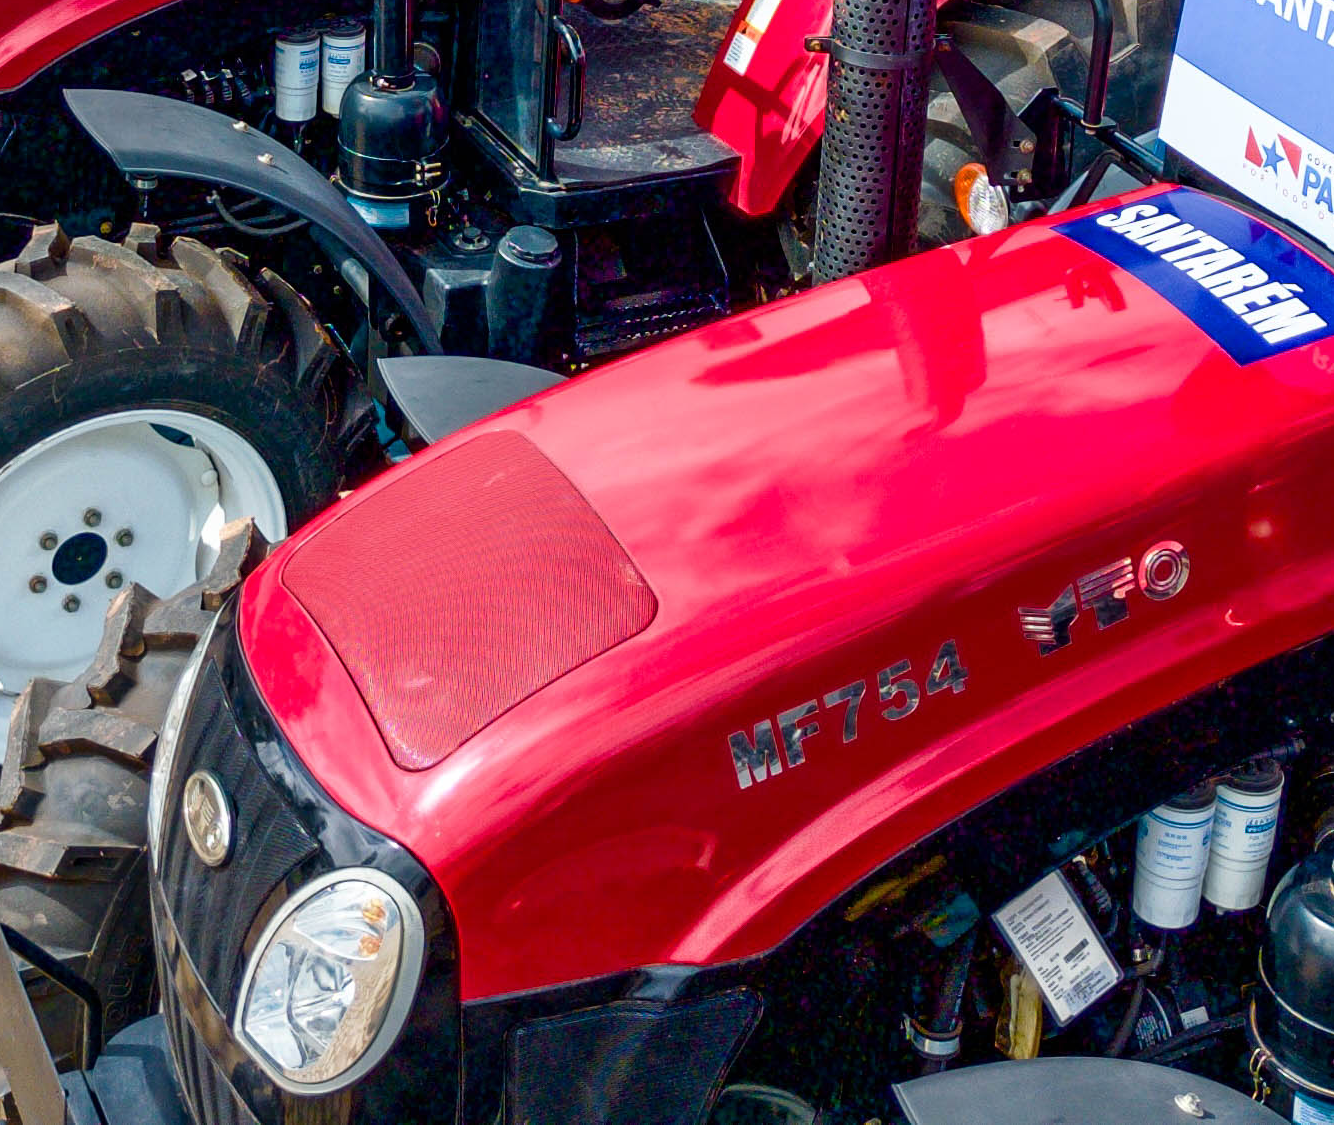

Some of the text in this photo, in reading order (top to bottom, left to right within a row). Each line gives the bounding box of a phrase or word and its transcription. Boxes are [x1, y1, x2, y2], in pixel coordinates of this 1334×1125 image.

[1096, 204, 1328, 344] SANTARÉM
[1018, 540, 1190, 657] YTO
[727, 639, 968, 790] MF754
